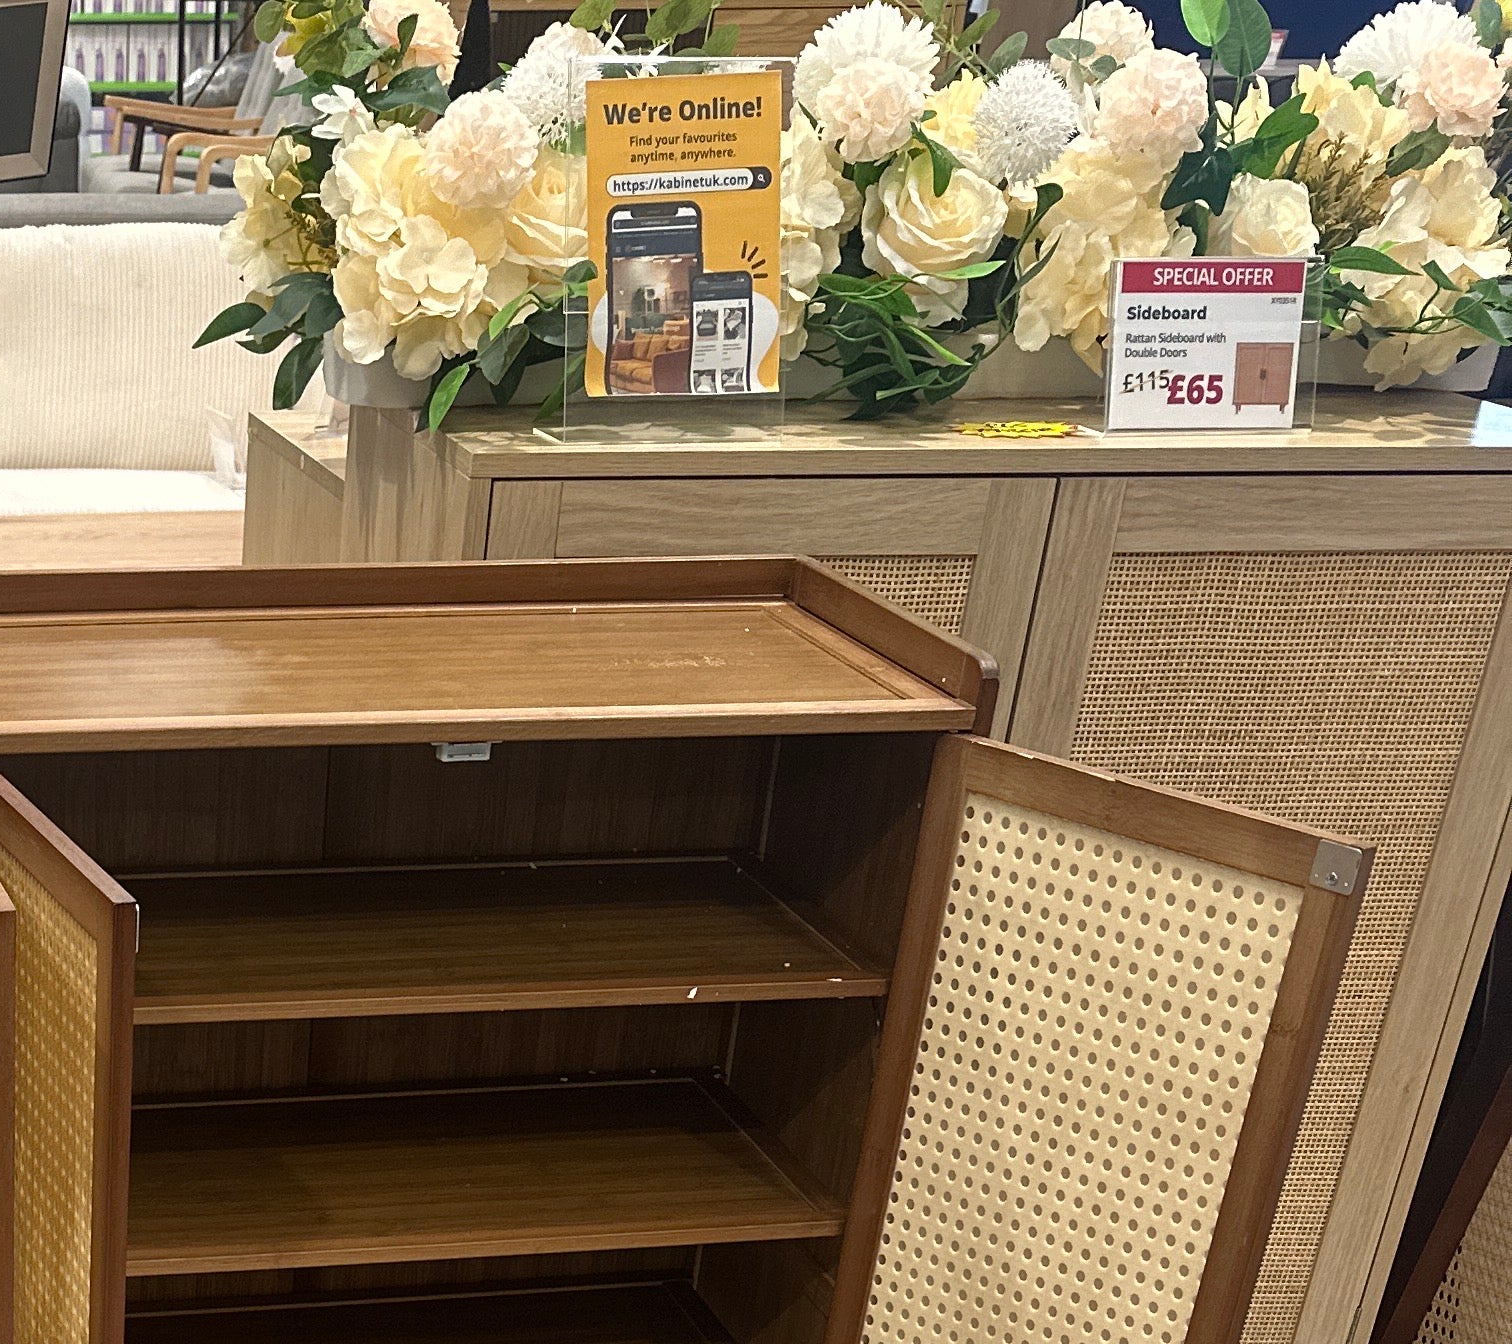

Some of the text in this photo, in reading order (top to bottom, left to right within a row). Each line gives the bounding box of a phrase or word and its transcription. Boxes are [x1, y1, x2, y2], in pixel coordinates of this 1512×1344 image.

[603, 96, 762, 125] We're Online!
[629, 132, 737, 148] Find your favourites
[630, 148, 736, 165] anytime, anywhere.
[613, 174, 749, 194] https://kabinetuk.com
[1153, 268, 1274, 286] SPECIAL OFFER
[1127, 305, 1207, 320] Sideboard
[1125, 332, 1226, 344] Rattan Sideboard with
[1124, 347, 1188, 358] Double Doors
[1122, 369, 1224, 405] £115 £65
